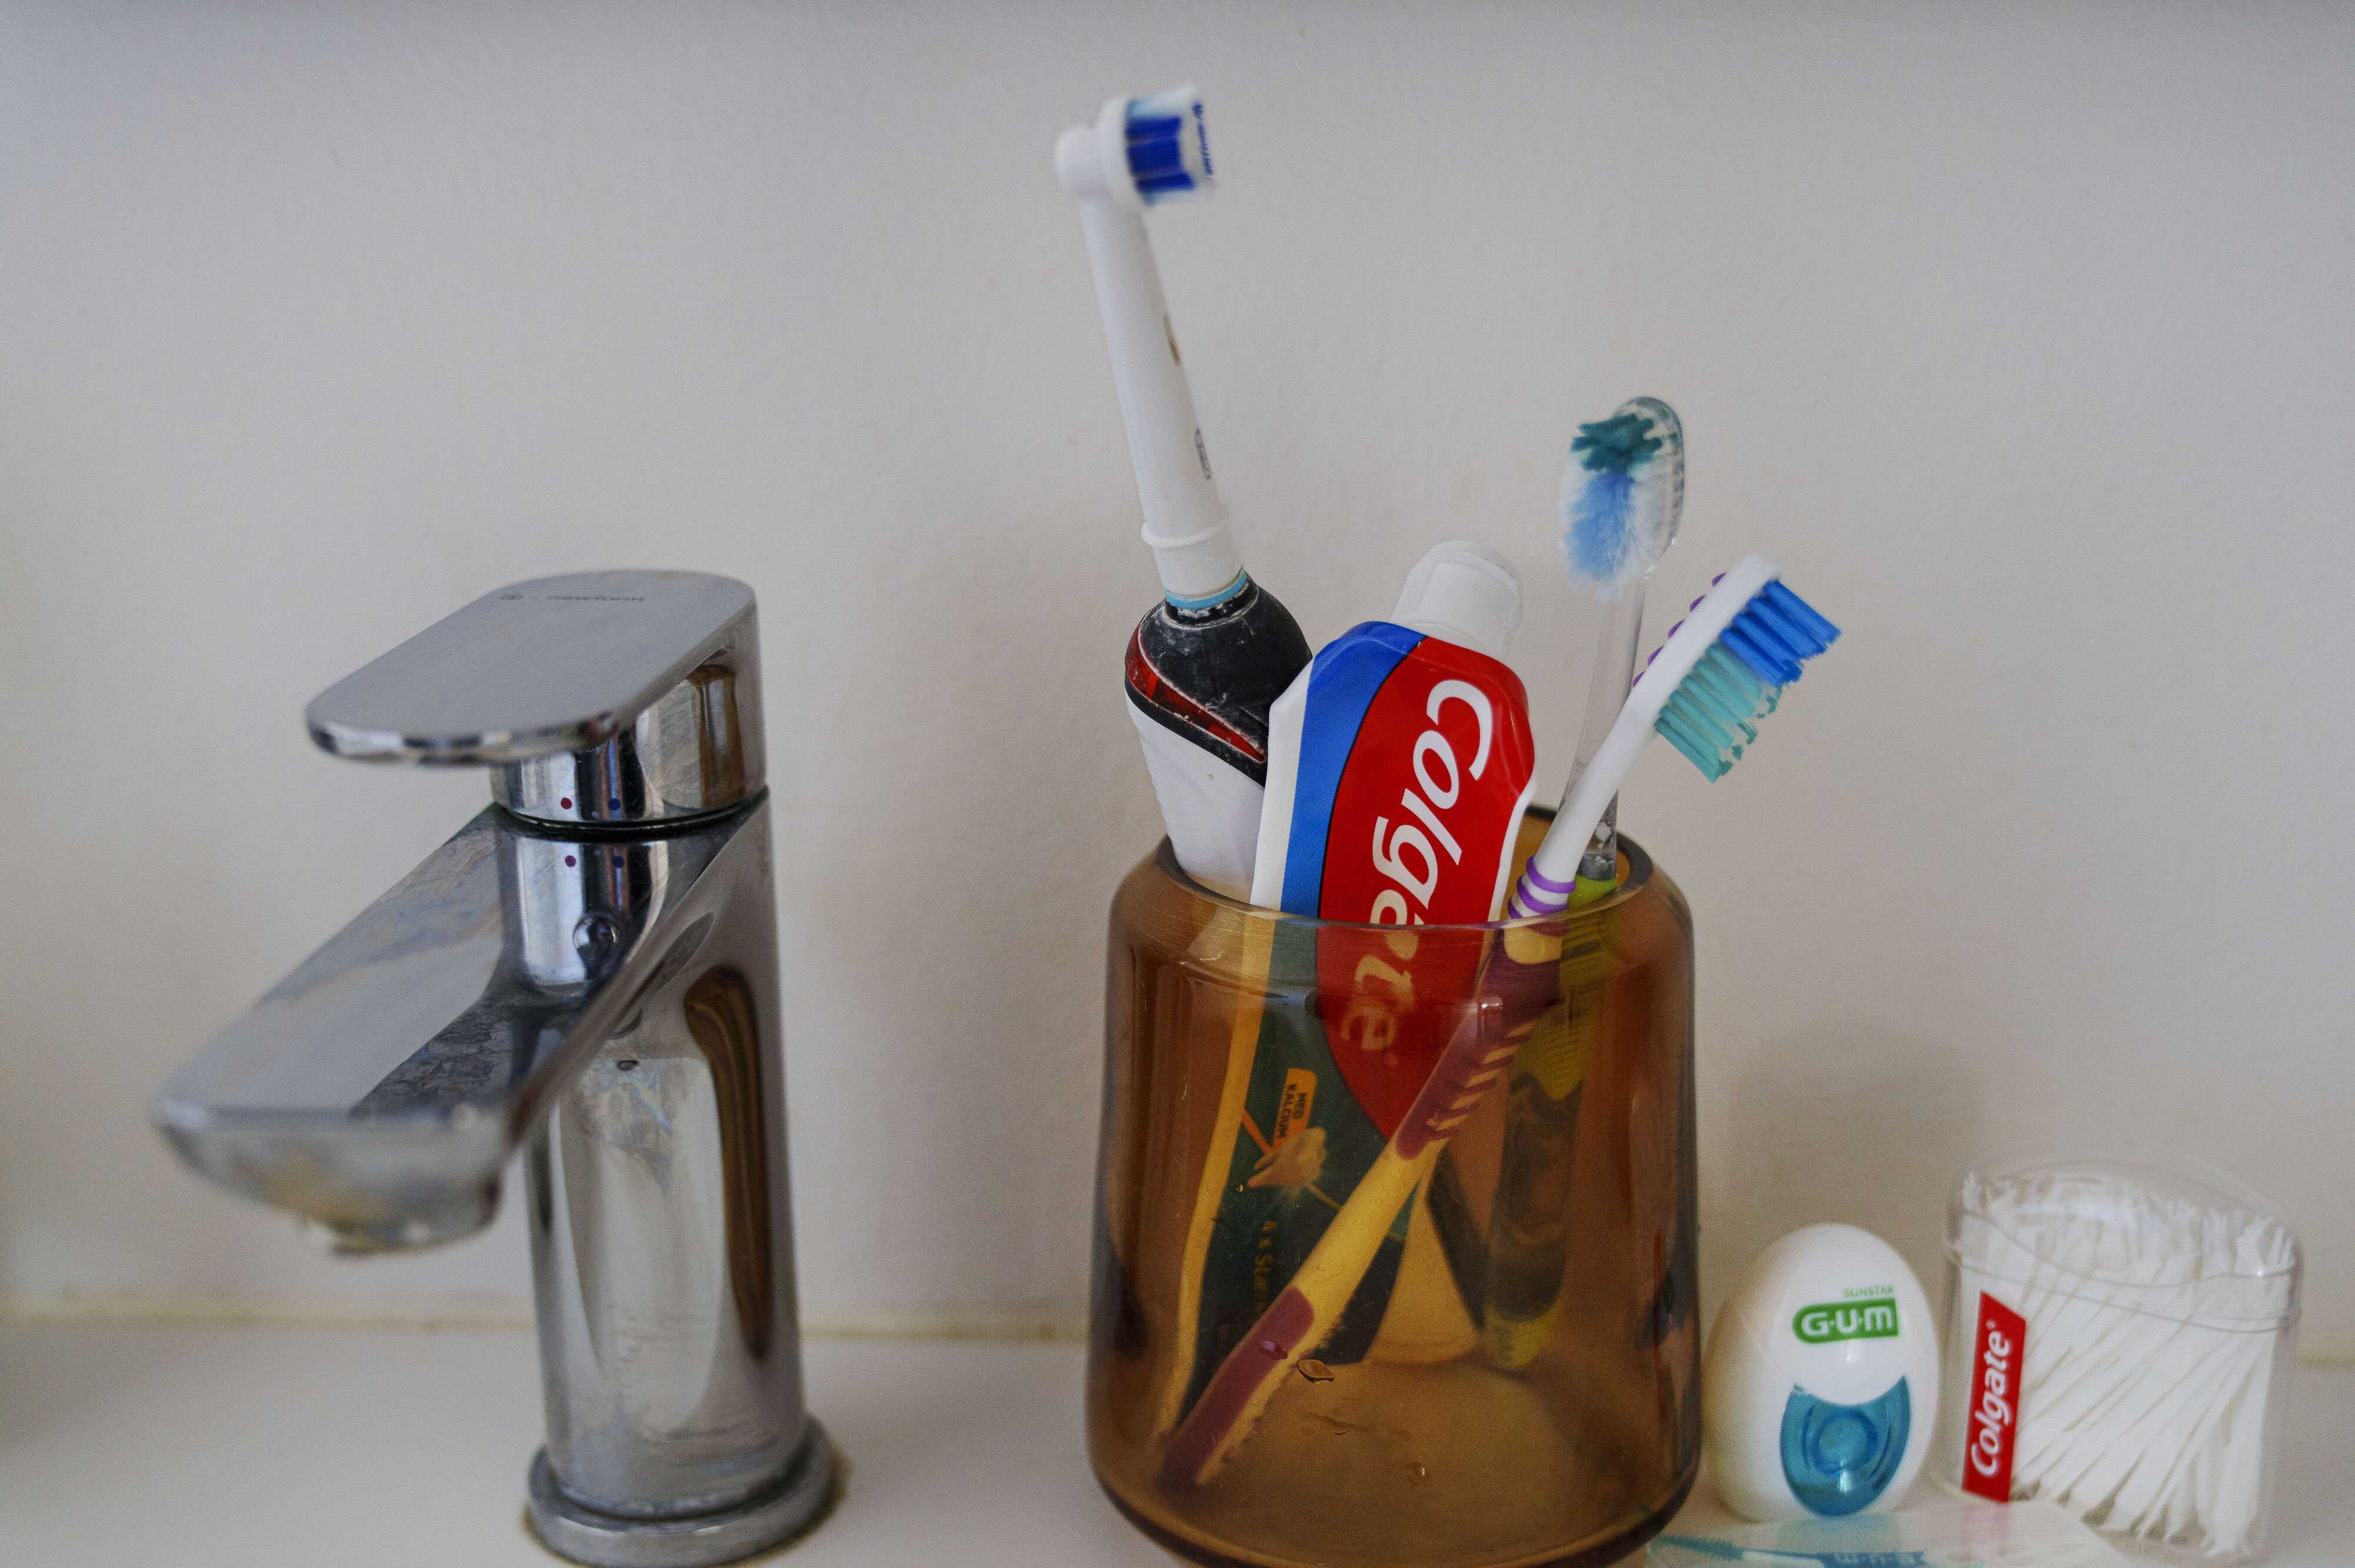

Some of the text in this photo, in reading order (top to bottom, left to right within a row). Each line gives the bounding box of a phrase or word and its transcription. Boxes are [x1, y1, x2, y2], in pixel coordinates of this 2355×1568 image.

[1340, 679, 1492, 1051] Colgate
[1294, 1092, 1307, 1119] MED
[1843, 1285, 1894, 1297] SUNSTAR
